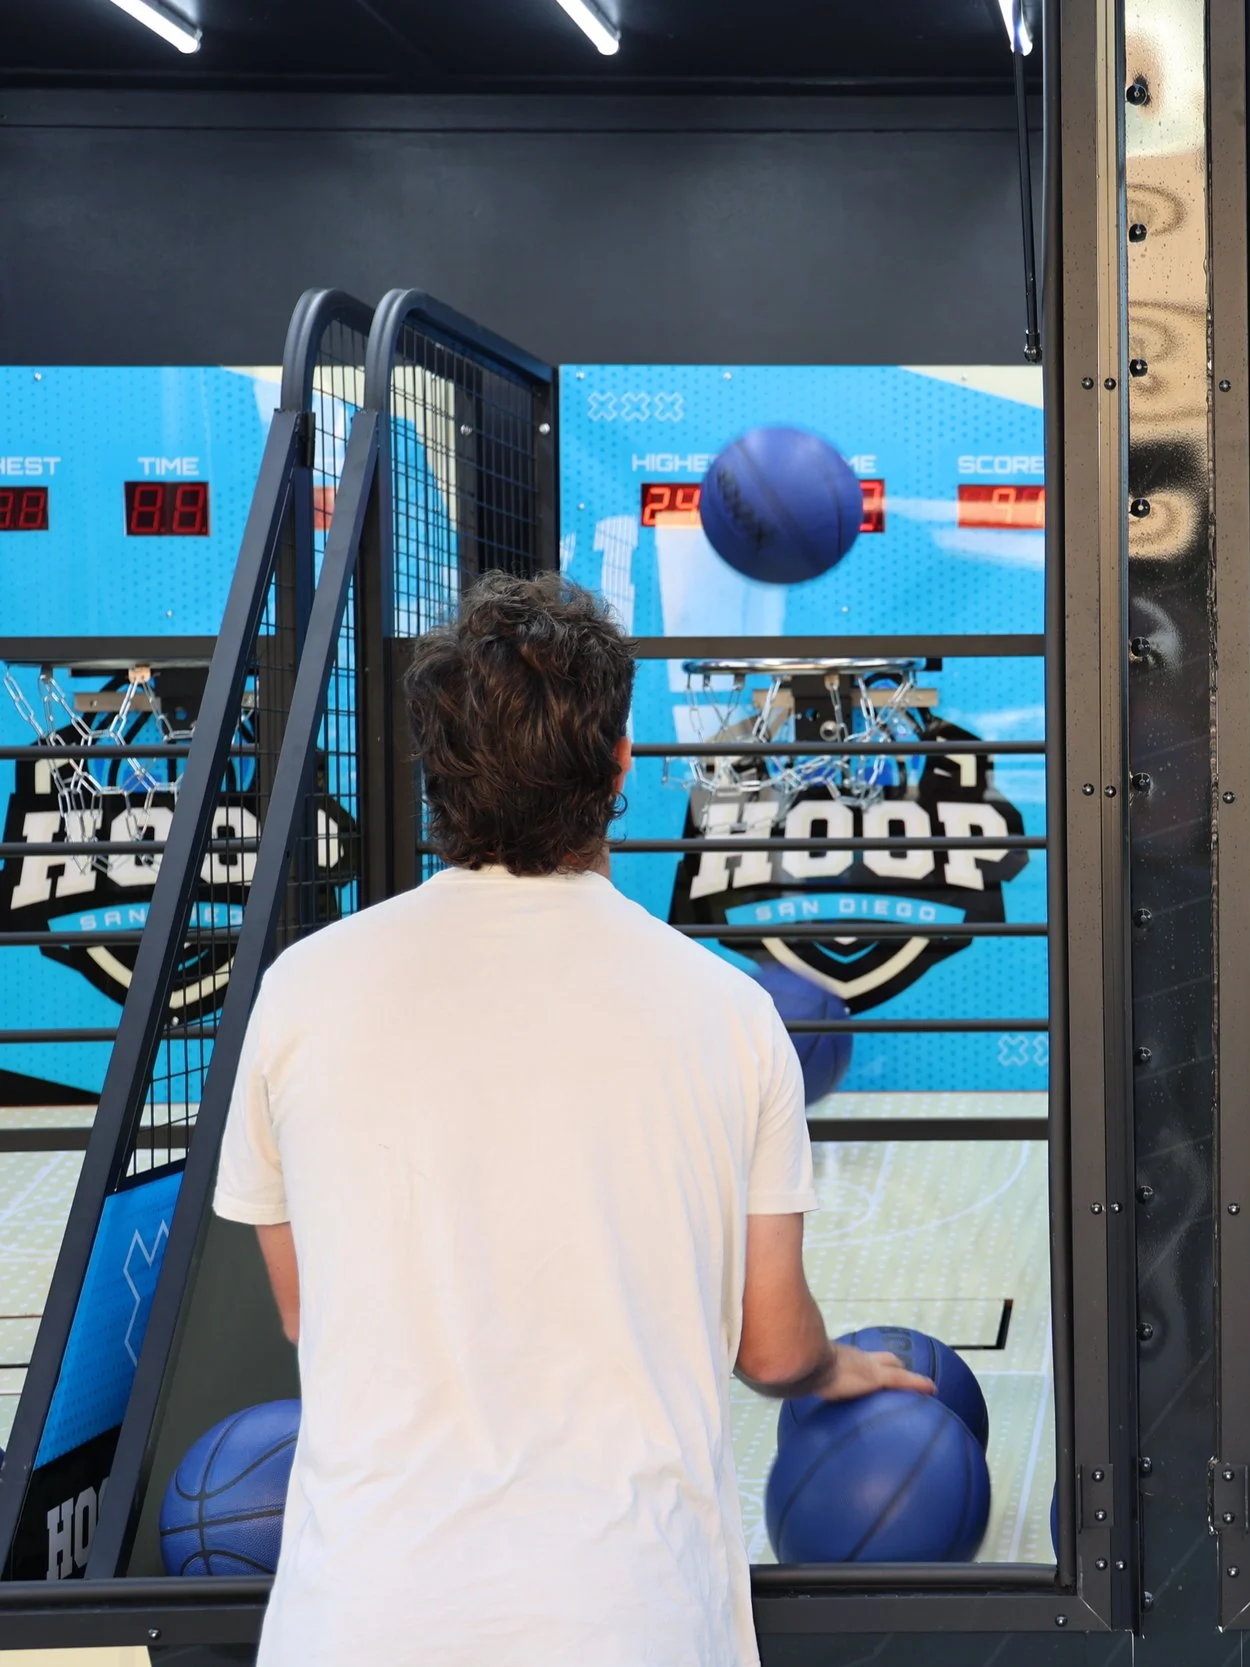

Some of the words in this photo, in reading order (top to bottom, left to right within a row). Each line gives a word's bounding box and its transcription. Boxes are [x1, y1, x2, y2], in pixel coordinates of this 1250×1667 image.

[138, 457, 199, 475] TIME
[957, 455, 1044, 474] SCORE
[690, 800, 1009, 899] HOOP
[755, 900, 819, 921] SAN
[840, 899, 936, 922] DIEGO
